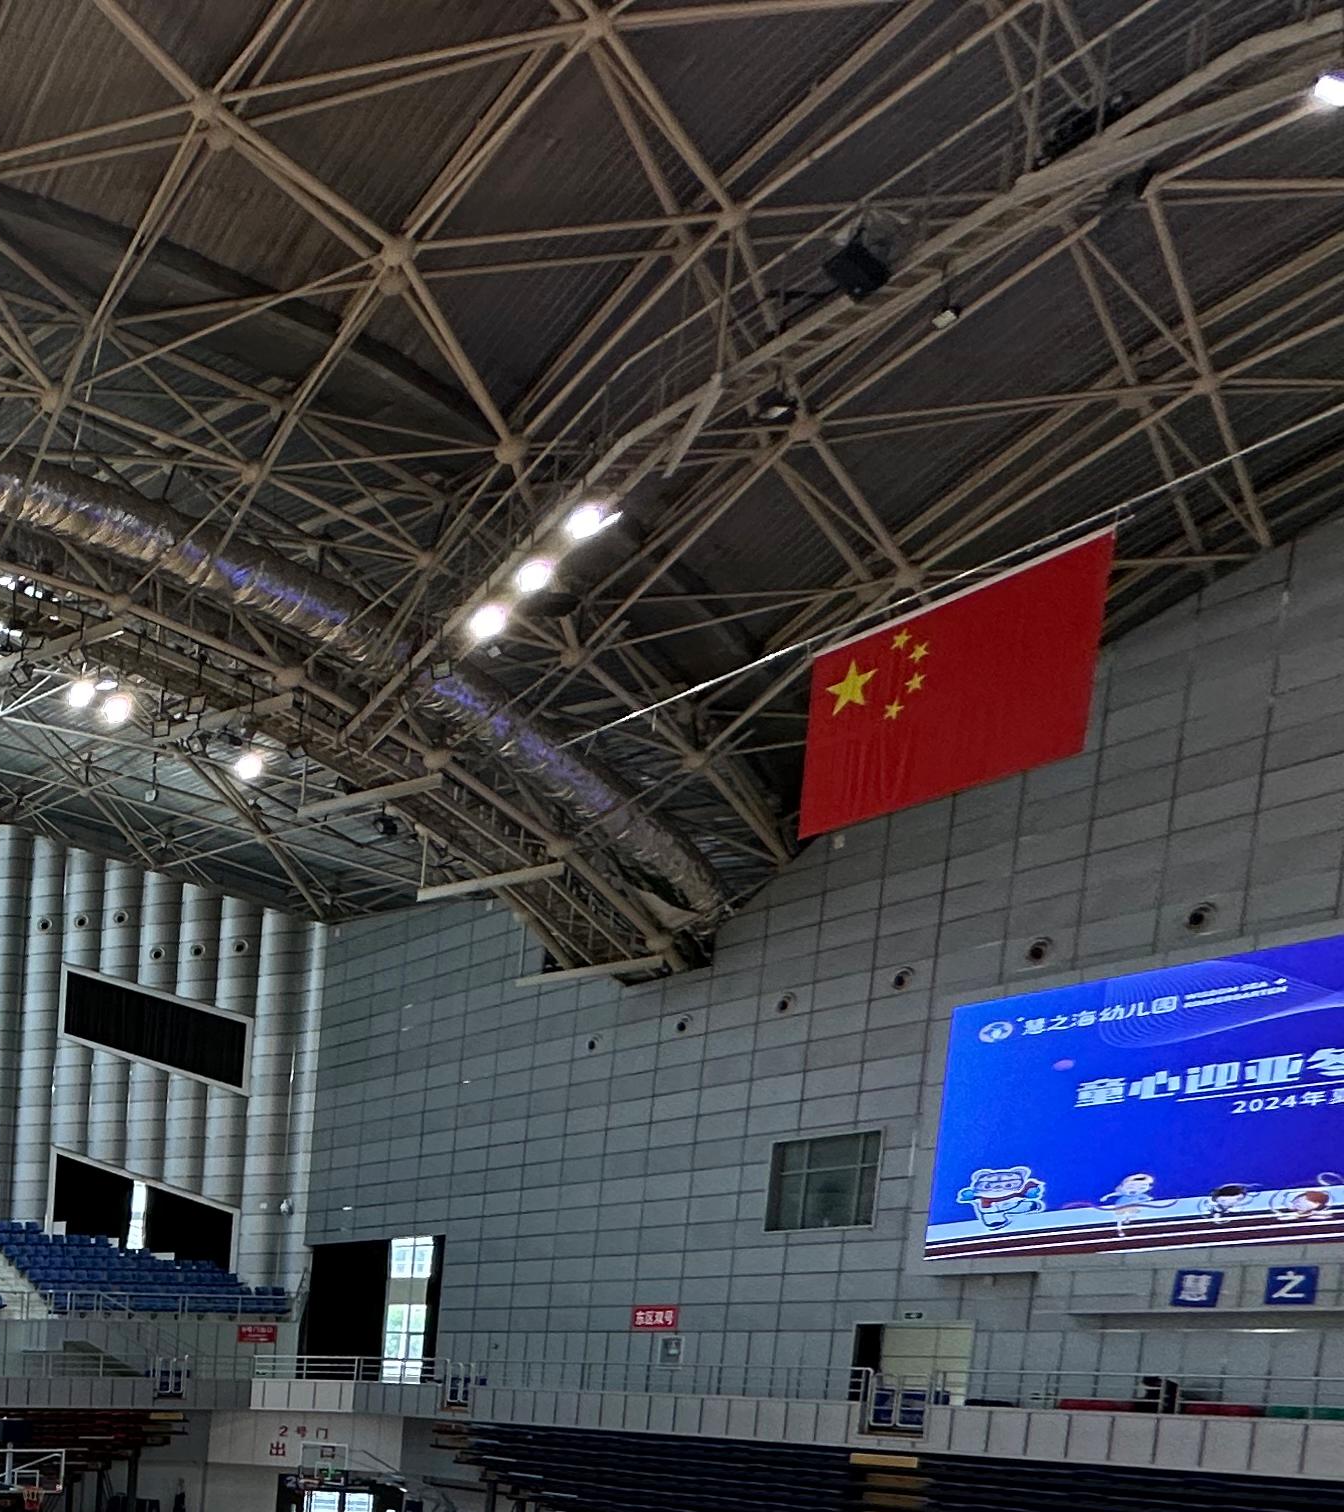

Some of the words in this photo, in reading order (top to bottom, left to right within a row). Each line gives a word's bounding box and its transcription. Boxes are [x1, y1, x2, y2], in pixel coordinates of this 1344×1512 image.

[1023, 996, 1177, 1035] 慧之海幼儿园
[1272, 1270, 1306, 1298] 之
[635, 1310, 674, 1325] 东区双号
[278, 1425, 329, 1440] 2号门
[269, 1442, 336, 1459] 出口
